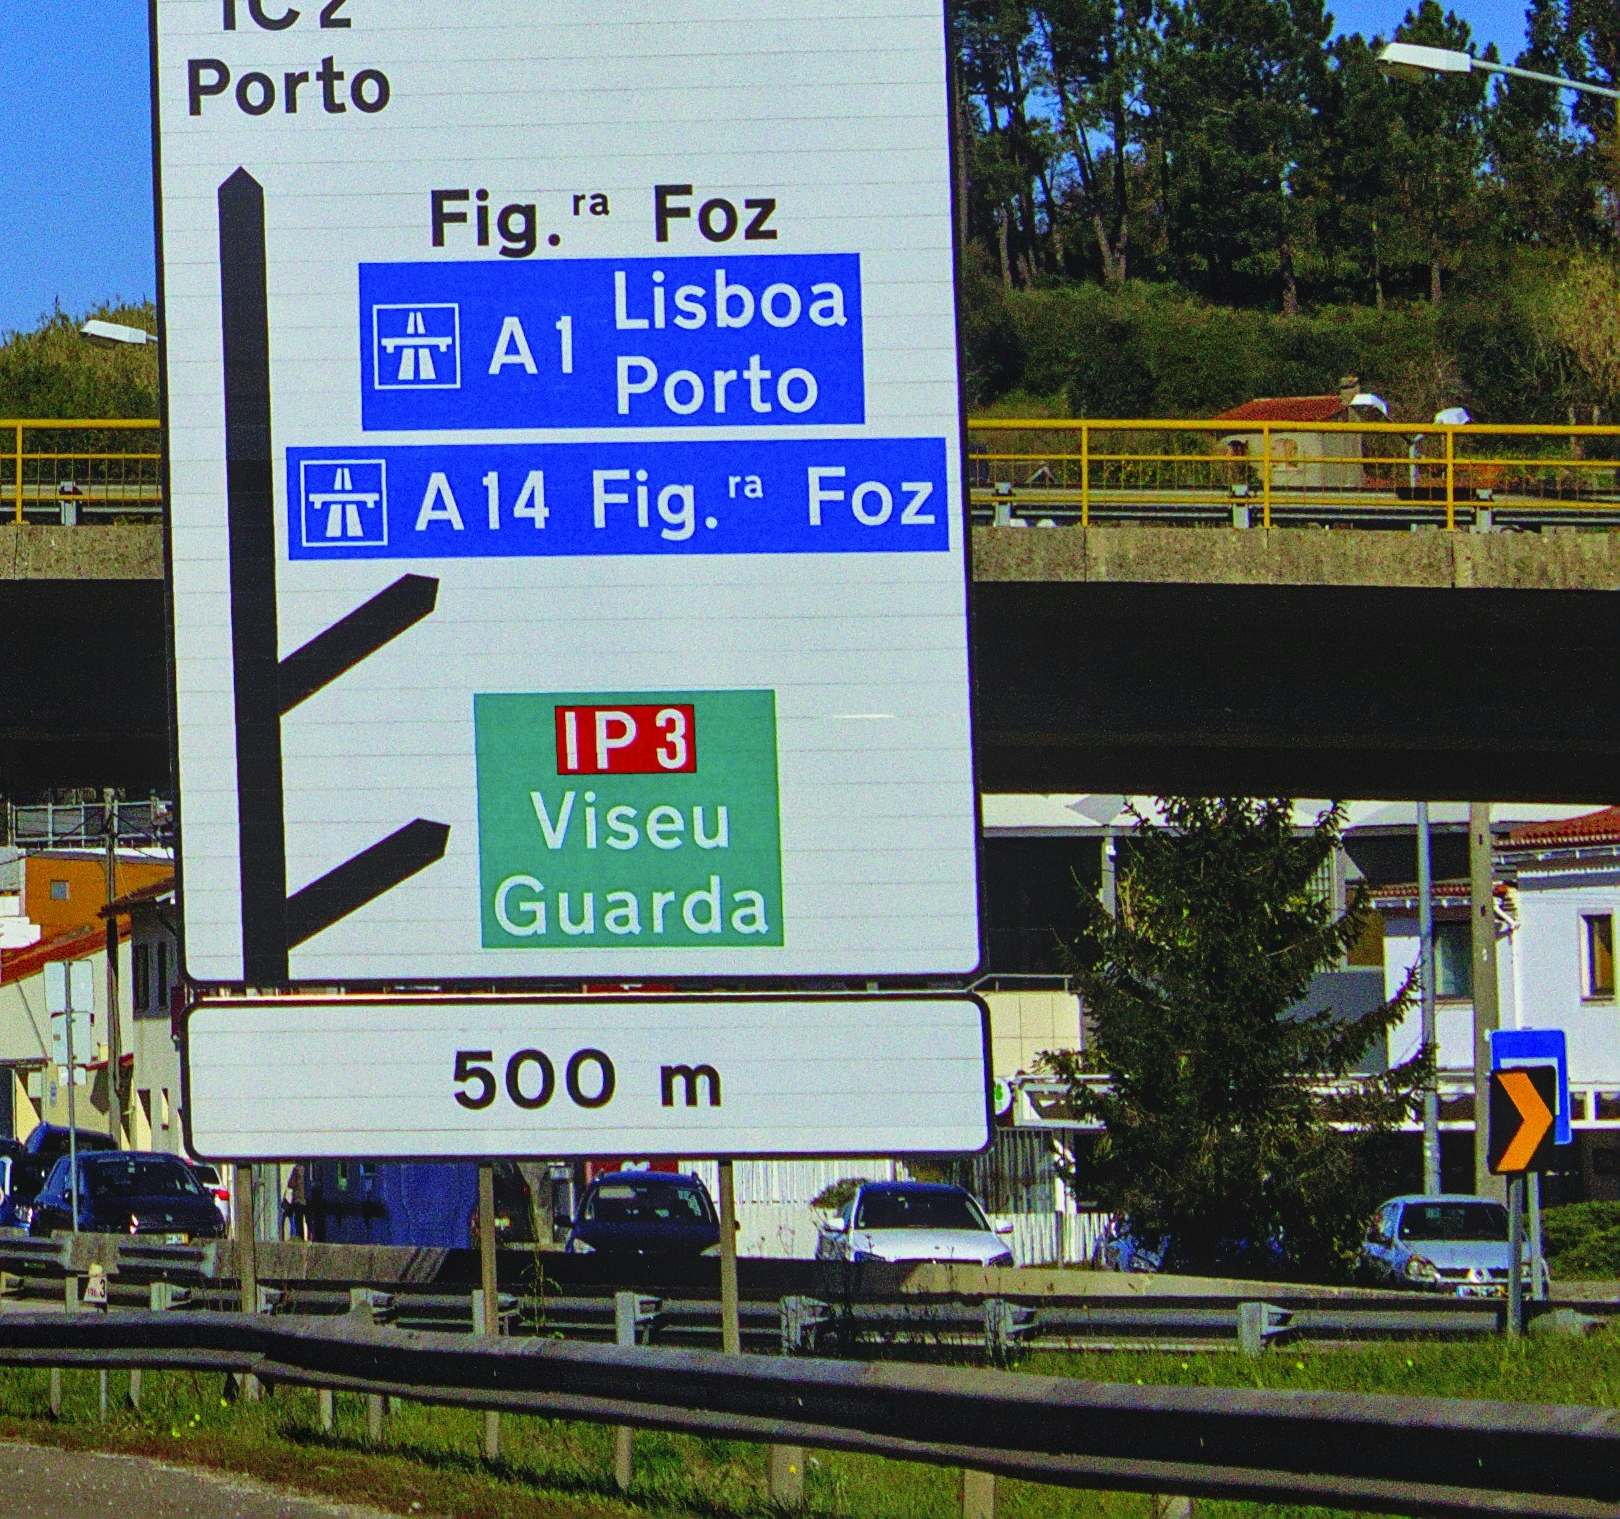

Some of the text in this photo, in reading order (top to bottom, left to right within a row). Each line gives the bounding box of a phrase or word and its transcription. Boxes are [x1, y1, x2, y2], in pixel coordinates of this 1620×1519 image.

[187, 55, 391, 117] Porto
[654, 183, 778, 243] Foz
[614, 268, 848, 330] Lisboa
[616, 353, 819, 416] Porto
[807, 465, 936, 528] Foz
[529, 790, 729, 850] Viseu
[494, 874, 769, 937] Guarda
[453, 1047, 722, 1111] 500 m
